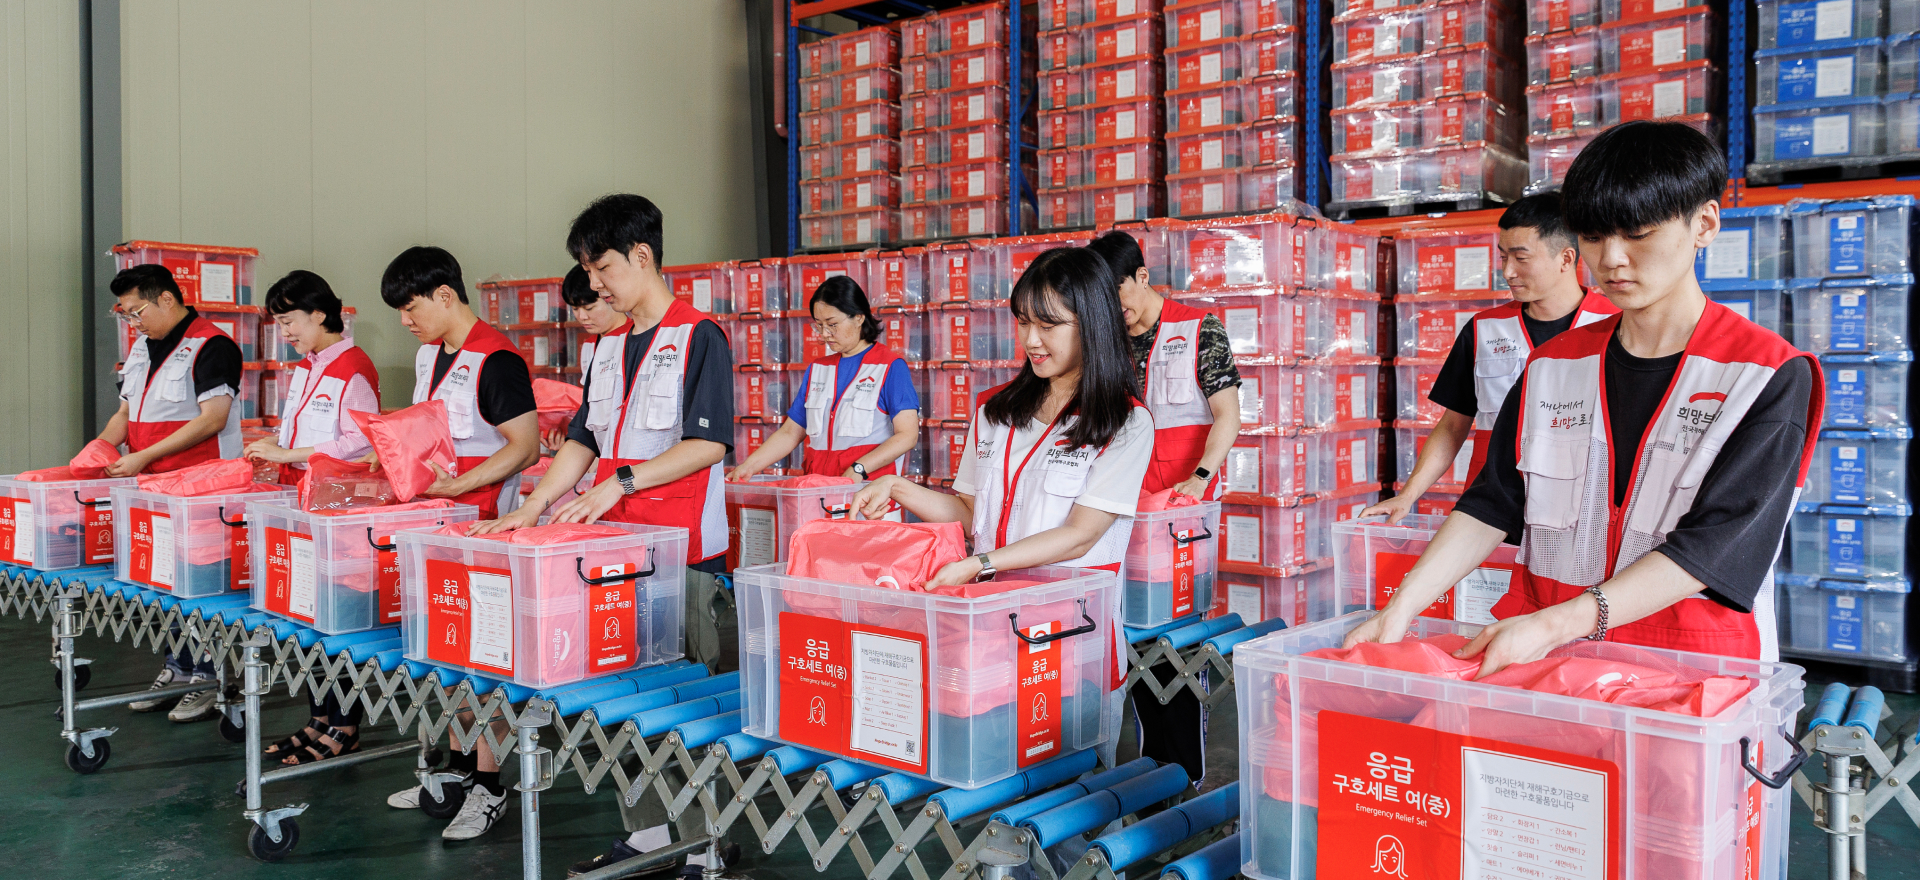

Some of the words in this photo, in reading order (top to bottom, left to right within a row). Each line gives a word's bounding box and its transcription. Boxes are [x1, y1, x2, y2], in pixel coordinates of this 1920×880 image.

[1540, 400, 1584, 414] 재난에서
[1550, 413, 1592, 430] 희망으로!
[1046, 448, 1089, 461] 희망브리지
[443, 579, 458, 595] 응급
[605, 590, 620, 602] 응급
[805, 638, 830, 660] 응급
[788, 656, 823, 673] 구호세트
[826, 664, 847, 681] 여(중)
[1032, 658, 1048, 674] 응급
[800, 676, 820, 686] Emergency
[1022, 673, 1042, 688] 구호세트
[1044, 670, 1058, 681] 여(중)
[1366, 752, 1414, 784] 응급
[1333, 774, 1400, 802] 구호세트
[1405, 790, 1450, 818] 여(중)
[1479, 774, 1525, 790] 지방자치단체
[1527, 783, 1590, 803] 재해구호기금으로
[1495, 788, 1518, 800] 마련한
[1520, 791, 1574, 811] 구호물품입니다
[1356, 803, 1394, 820] Emergency
[1395, 812, 1414, 824] Relief
[1417, 818, 1427, 827] Set
[1487, 812, 1499, 821] 담요
[1487, 828, 1498, 836] 양말
[1518, 819, 1535, 829] 화장지
[1518, 835, 1534, 844] 면장갑
[1555, 828, 1572, 837] 간소복
